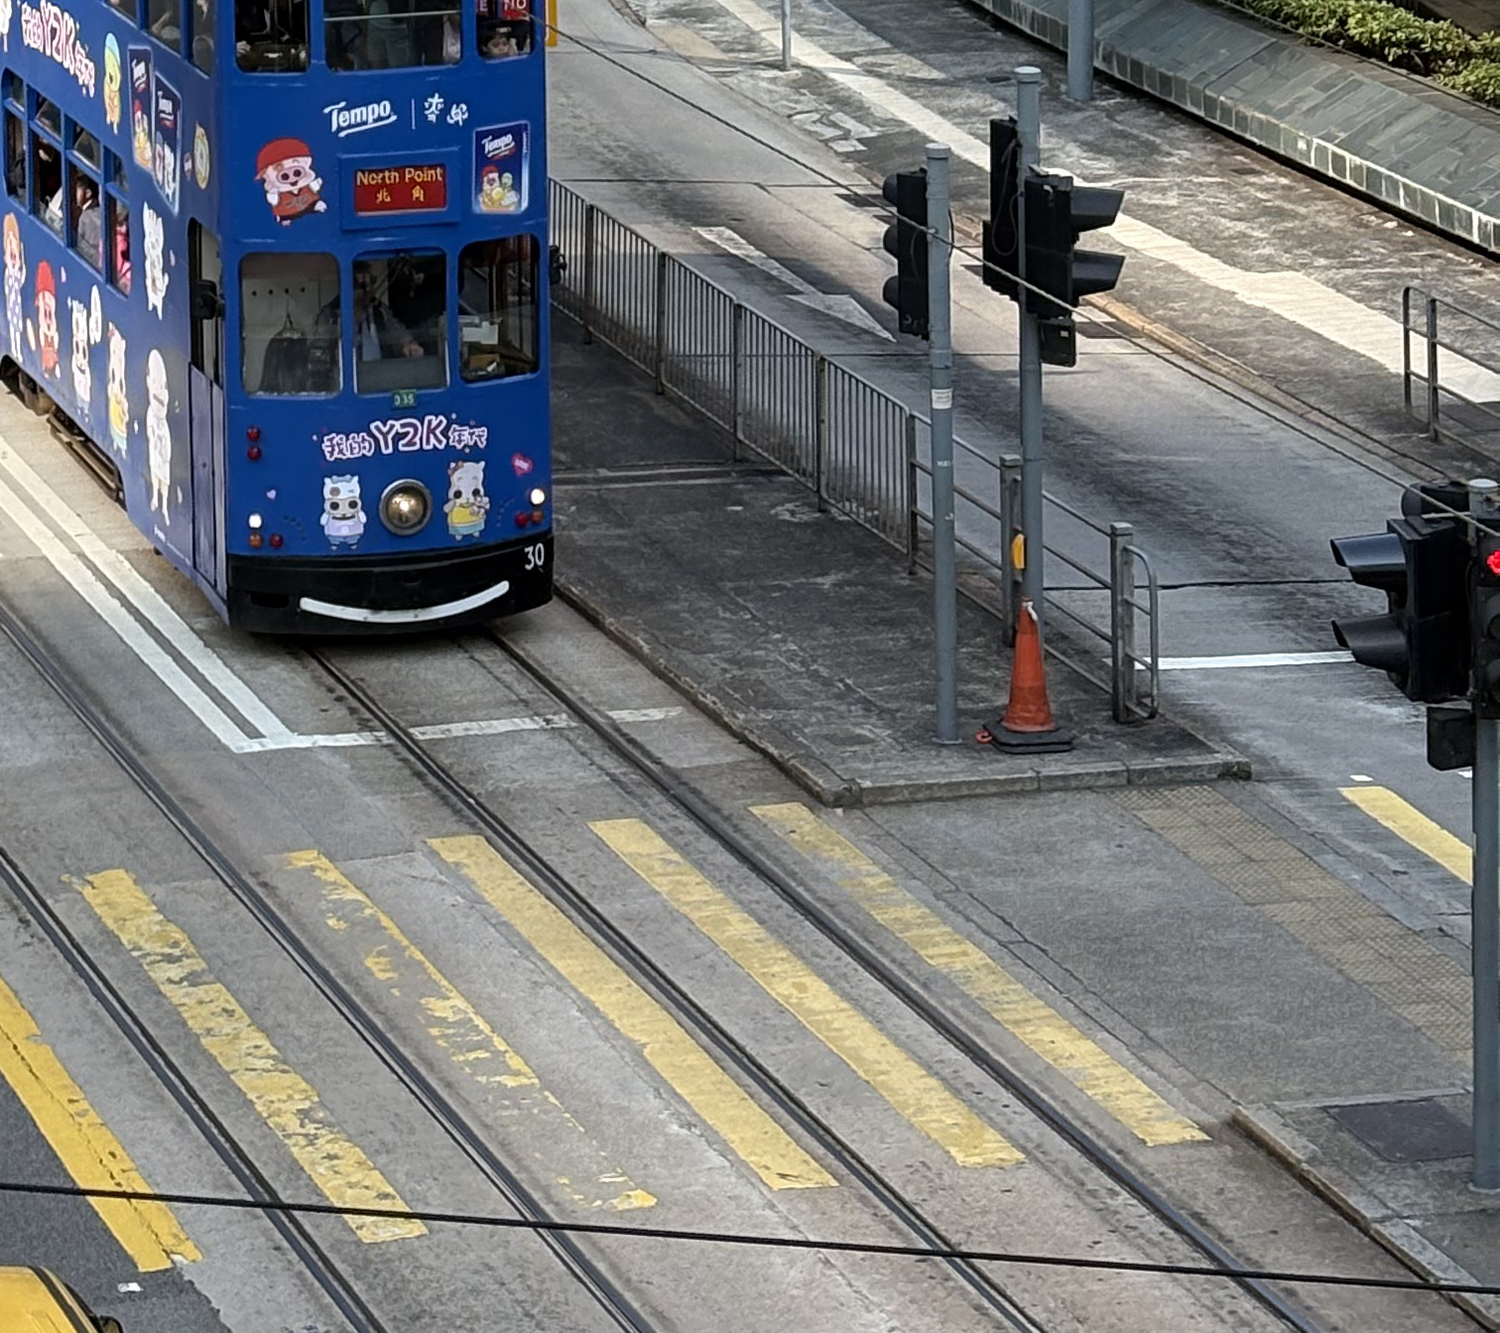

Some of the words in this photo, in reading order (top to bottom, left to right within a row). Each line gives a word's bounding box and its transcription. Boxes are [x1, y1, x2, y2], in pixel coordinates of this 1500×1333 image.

[323, 100, 397, 137] Tempo
[481, 134, 515, 157] Tempo
[357, 168, 400, 186] North
[405, 165, 443, 182] Point
[376, 185, 425, 203] 北角
[524, 542, 546, 571] 30
